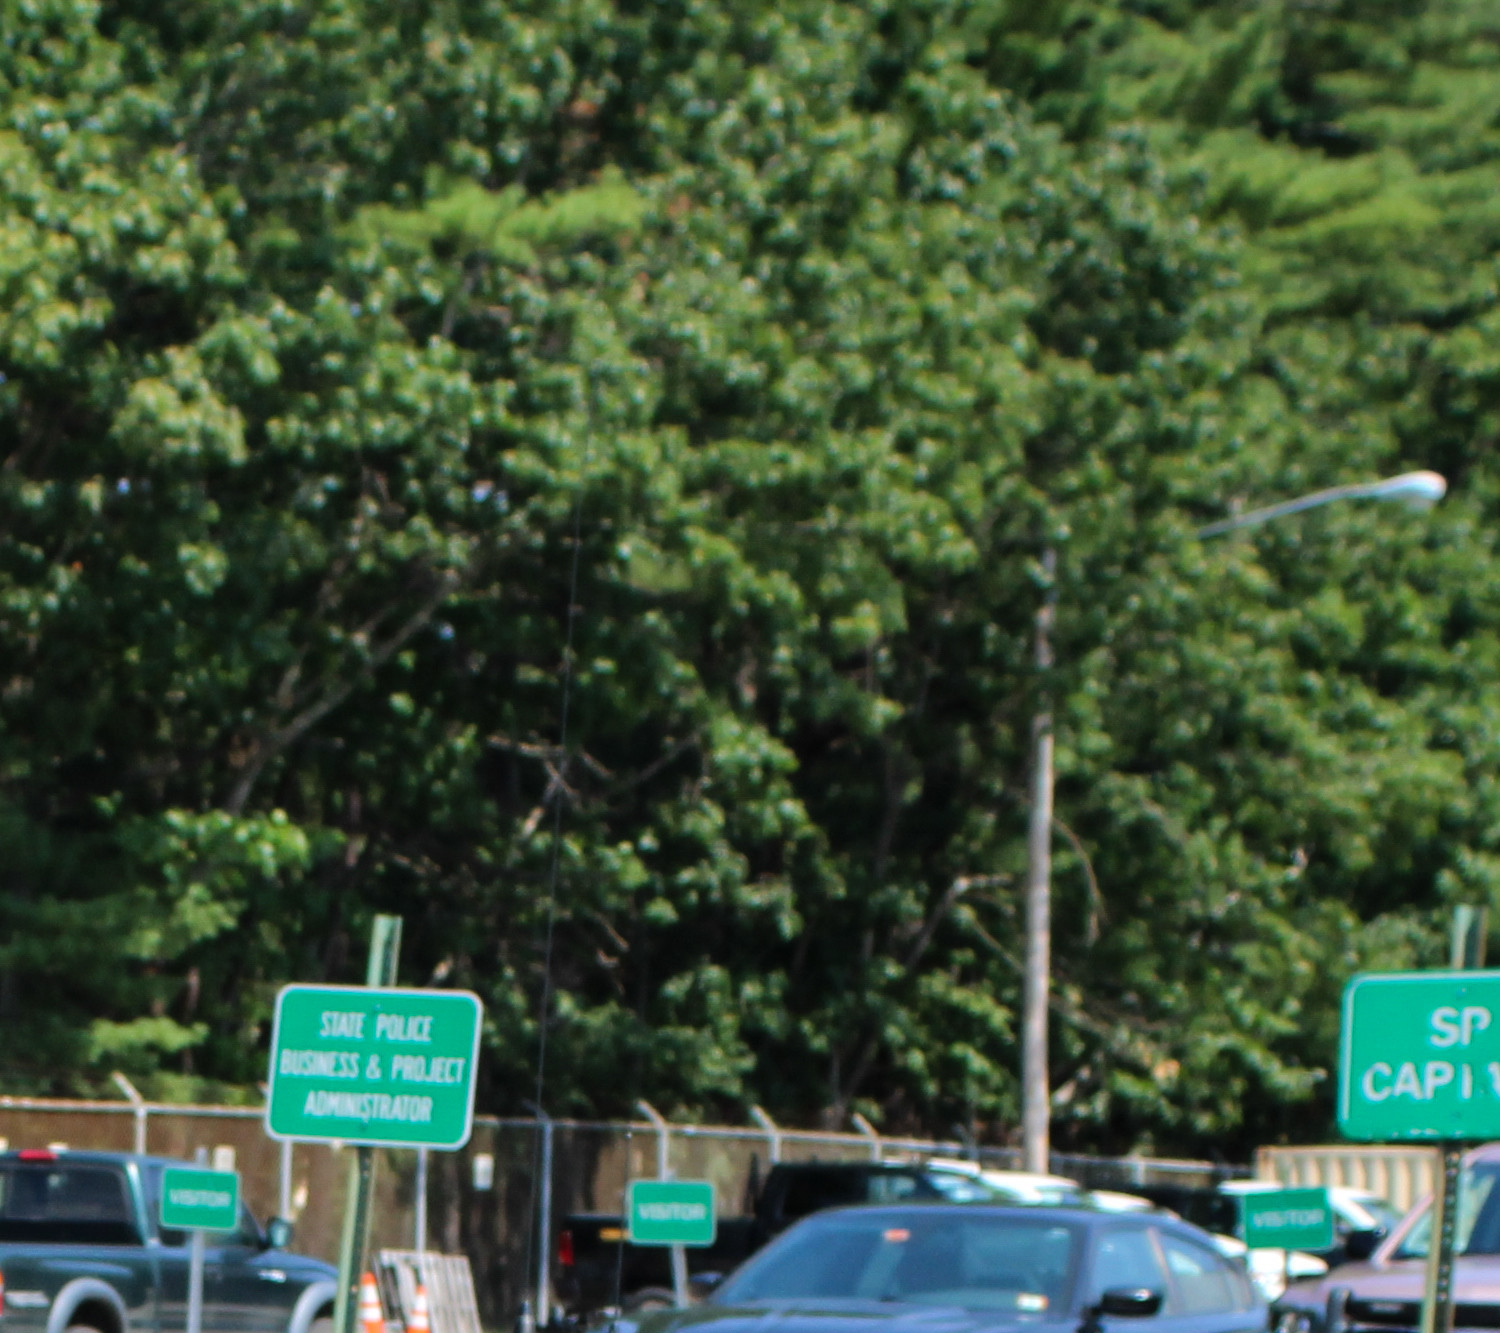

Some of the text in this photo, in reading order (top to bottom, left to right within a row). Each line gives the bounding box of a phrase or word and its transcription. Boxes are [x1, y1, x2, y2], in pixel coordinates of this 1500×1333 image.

[320, 1011, 434, 1042] STATE POLICE
[1430, 1005, 1492, 1048] SP
[279, 1049, 467, 1083] BUSINESS & PROJECT
[304, 1090, 434, 1122] ADMINISTRATOR
[169, 1188, 232, 1207] VISITOR
[638, 1202, 706, 1220] VISITOR
[1253, 1208, 1325, 1228] VISITOR
